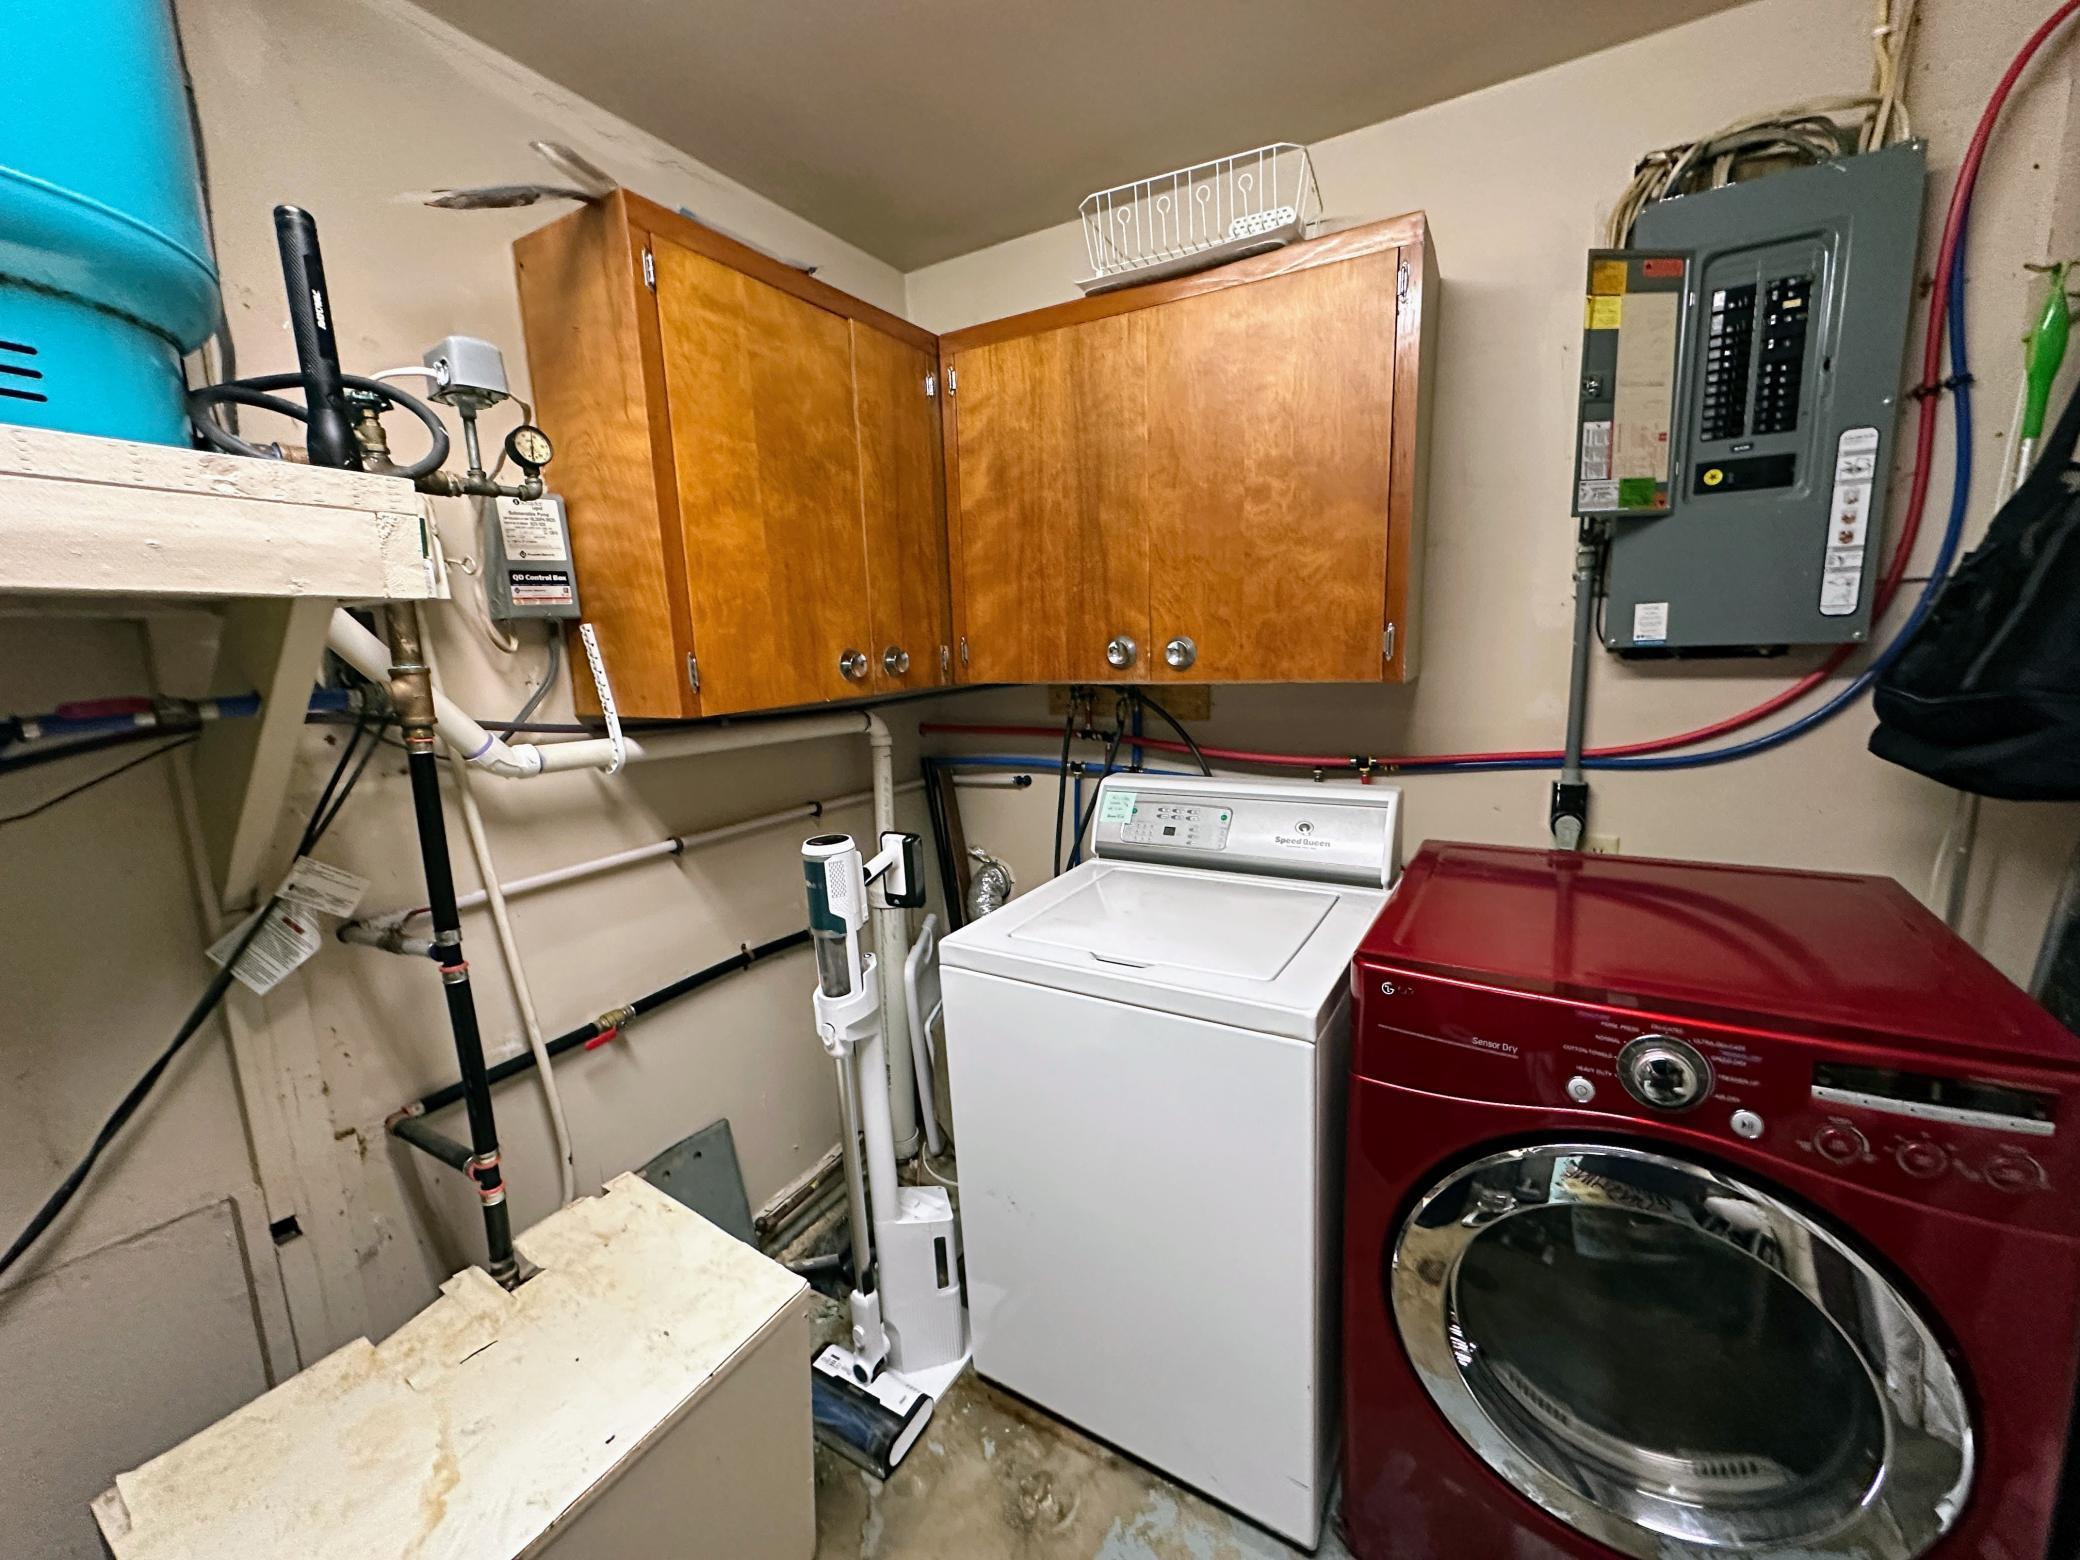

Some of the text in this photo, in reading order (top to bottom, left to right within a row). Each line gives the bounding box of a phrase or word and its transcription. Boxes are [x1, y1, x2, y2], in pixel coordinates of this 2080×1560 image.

[1275, 836, 1302, 845] Speed
[1303, 838, 1331, 848] Queen
[1472, 1037, 1518, 1054] Sensor Dry
